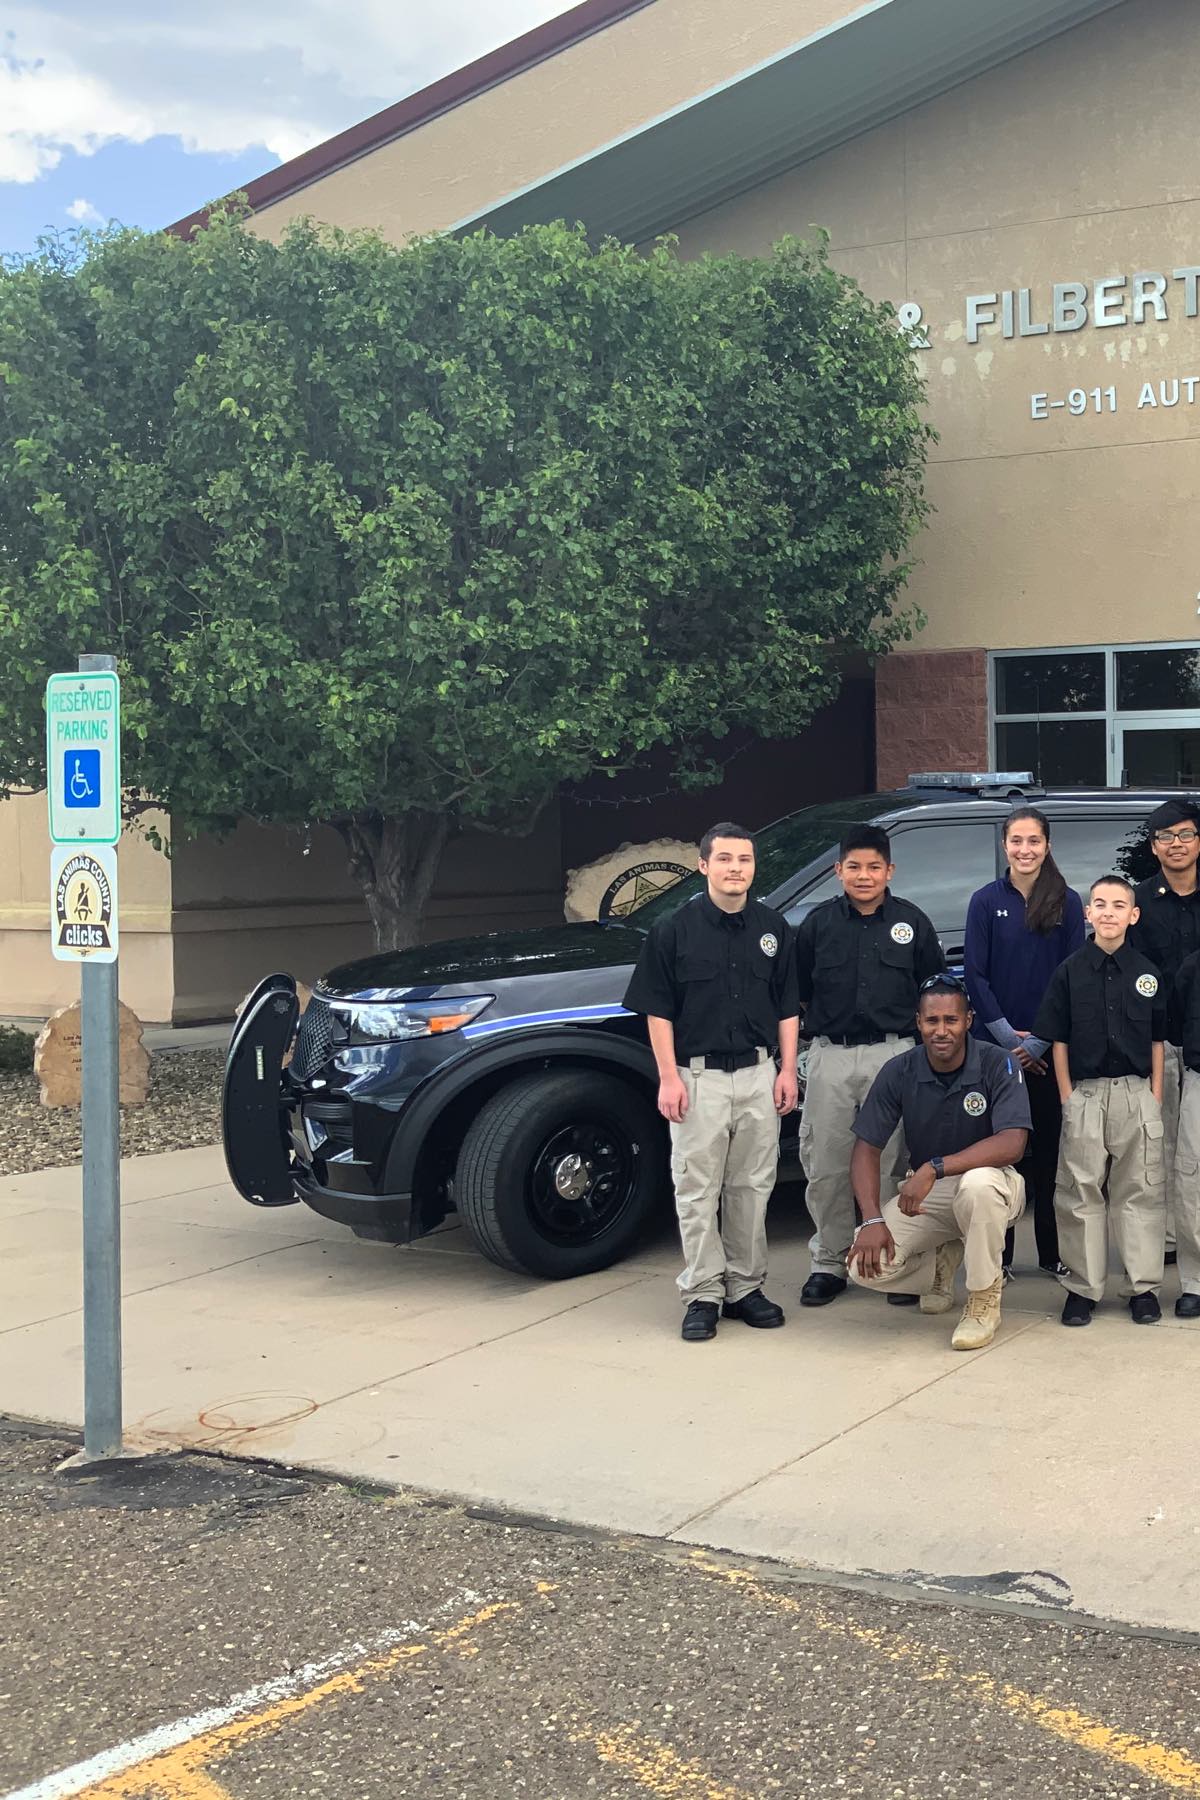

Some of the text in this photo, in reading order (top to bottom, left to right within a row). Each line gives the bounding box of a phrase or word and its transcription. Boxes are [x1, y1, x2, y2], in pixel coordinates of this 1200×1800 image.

[1031, 385, 1117, 419] E-911
[51, 690, 112, 713] RESERVED
[56, 719, 108, 741] PARKING
[57, 857, 111, 913] LAS ANIMAS COUNTY
[609, 863, 693, 894] LAS ANIMAS COU
[65, 924, 103, 946] clicks
